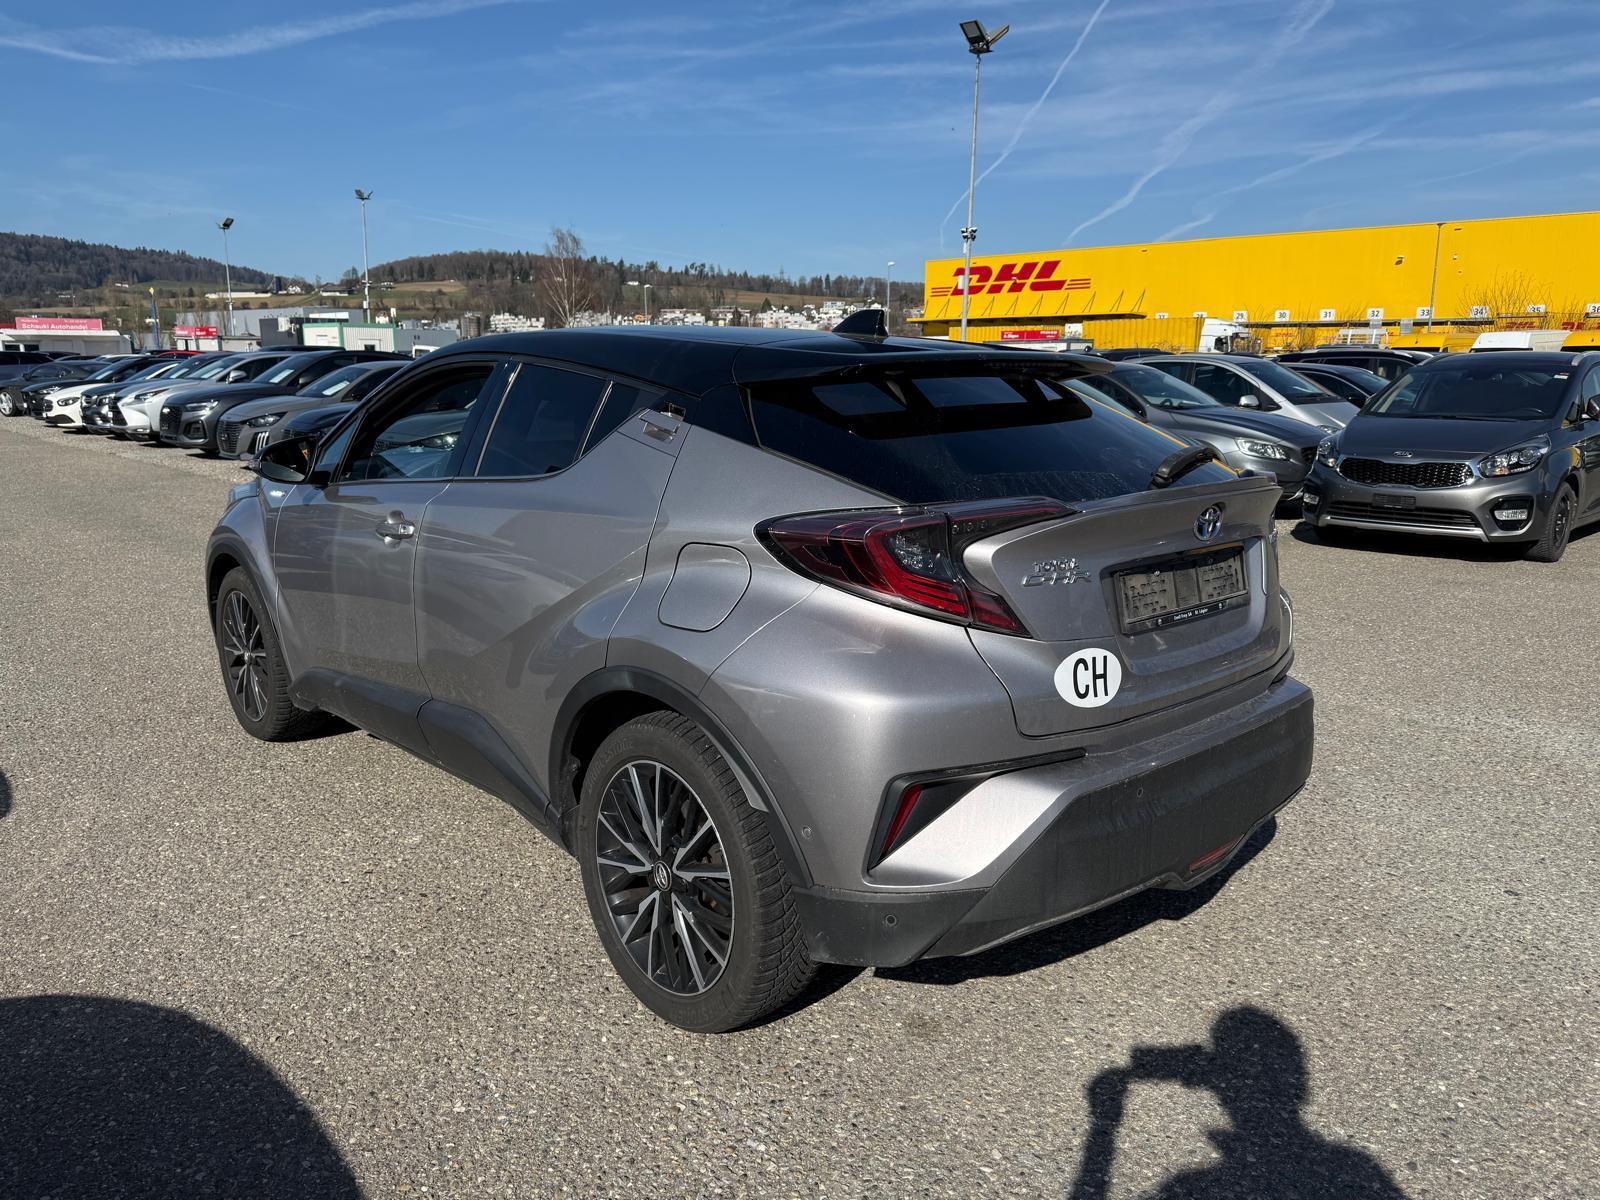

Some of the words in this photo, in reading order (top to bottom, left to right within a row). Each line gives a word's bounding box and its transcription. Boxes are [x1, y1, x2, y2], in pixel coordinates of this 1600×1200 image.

[950, 260, 1067, 297] DHL
[1236, 312, 1244, 320] 29
[1277, 311, 1287, 319] 30
[1322, 310, 1332, 319] 31
[1370, 309, 1380, 318] 32
[1419, 308, 1430, 317] 33
[1473, 307, 1484, 316] 34
[1073, 655, 1109, 699] CH
